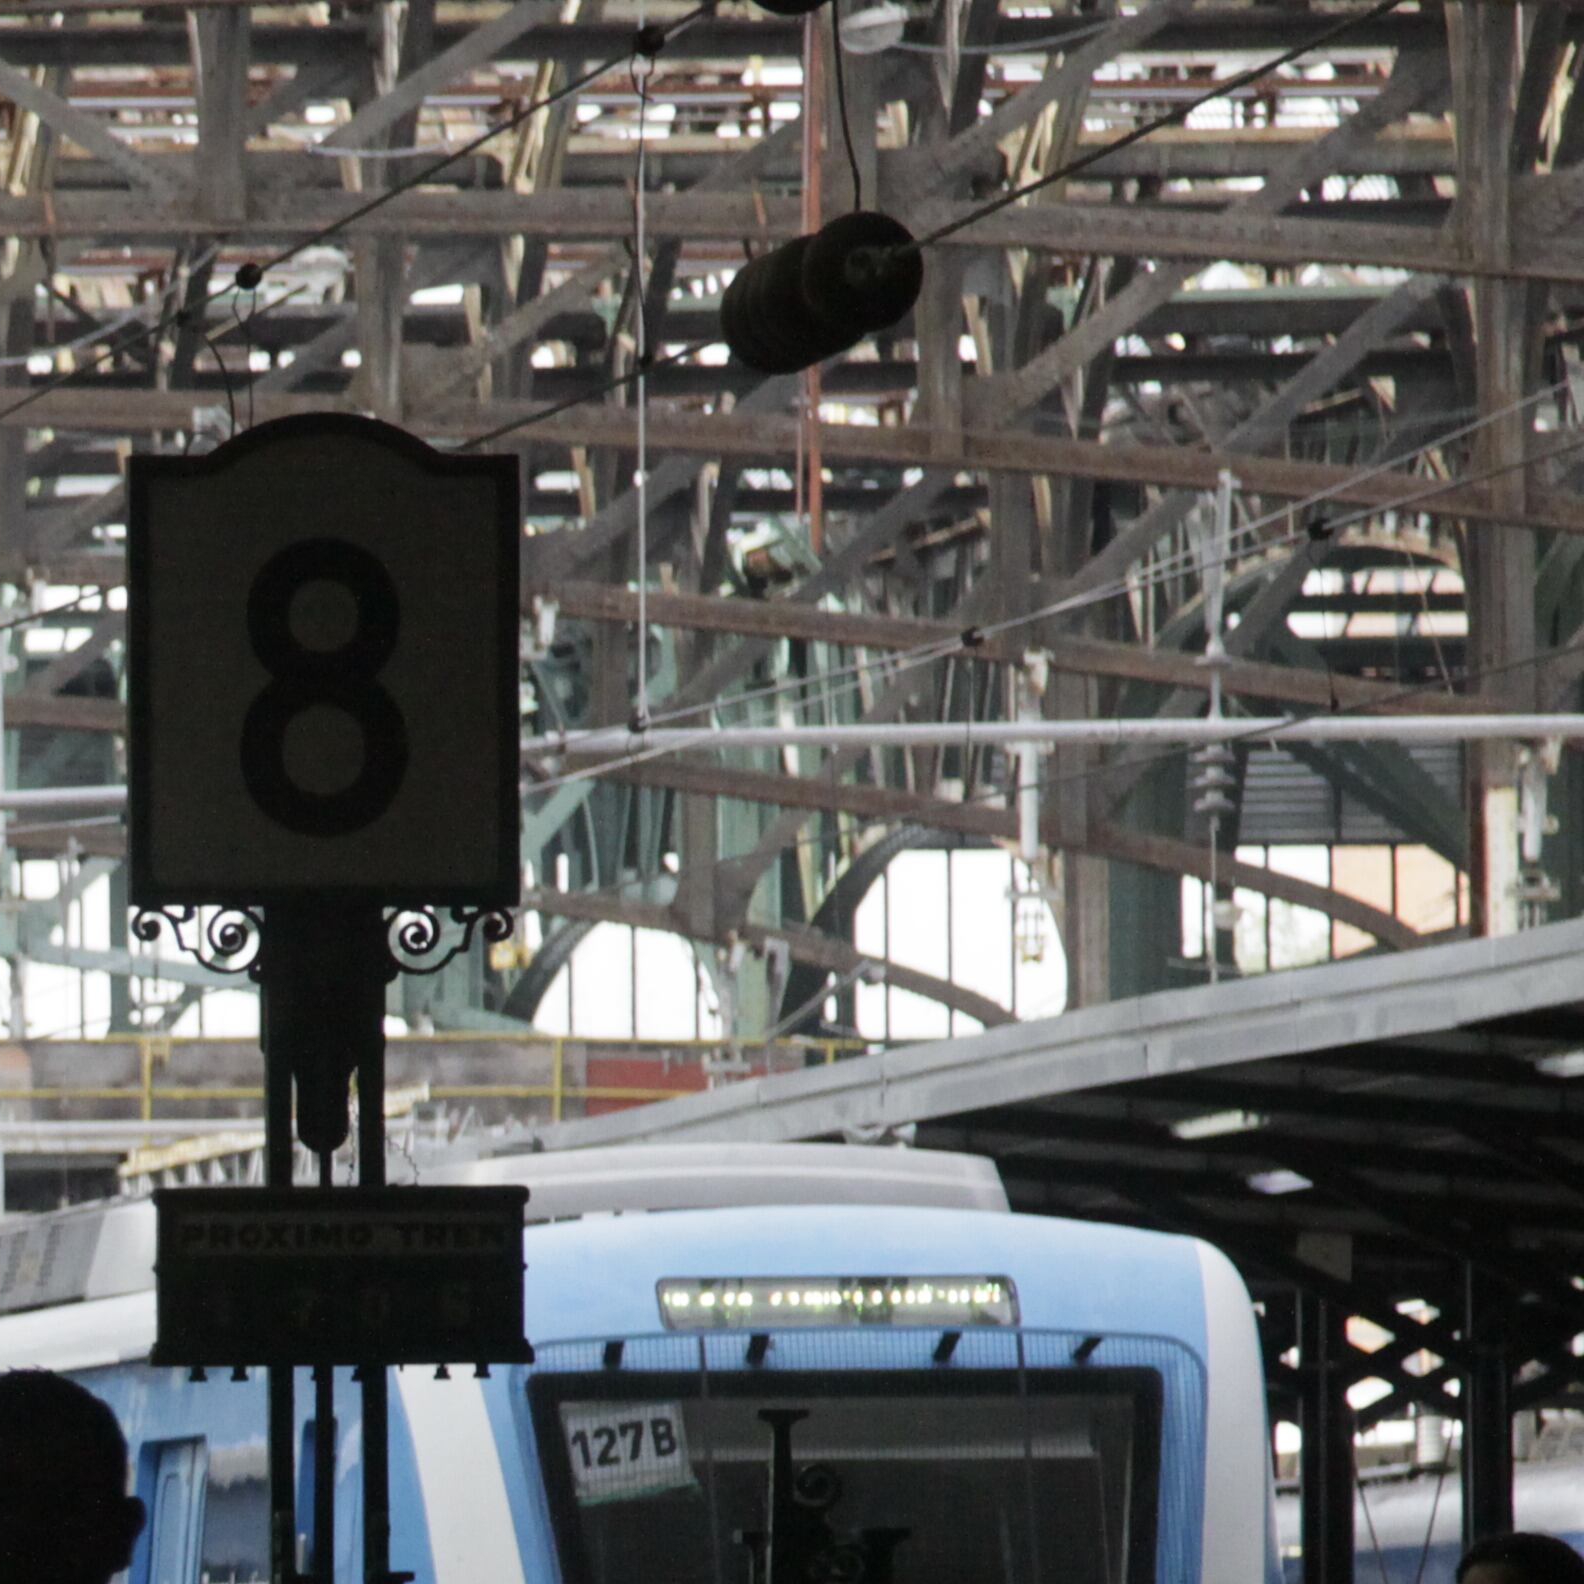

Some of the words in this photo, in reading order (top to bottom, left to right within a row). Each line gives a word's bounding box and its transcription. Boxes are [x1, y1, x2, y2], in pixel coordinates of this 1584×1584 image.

[239, 536, 409, 838] 8
[180, 1222, 374, 1250] PROXIMO
[394, 1221, 506, 1250] TREN
[571, 1416, 678, 1469] 127B
